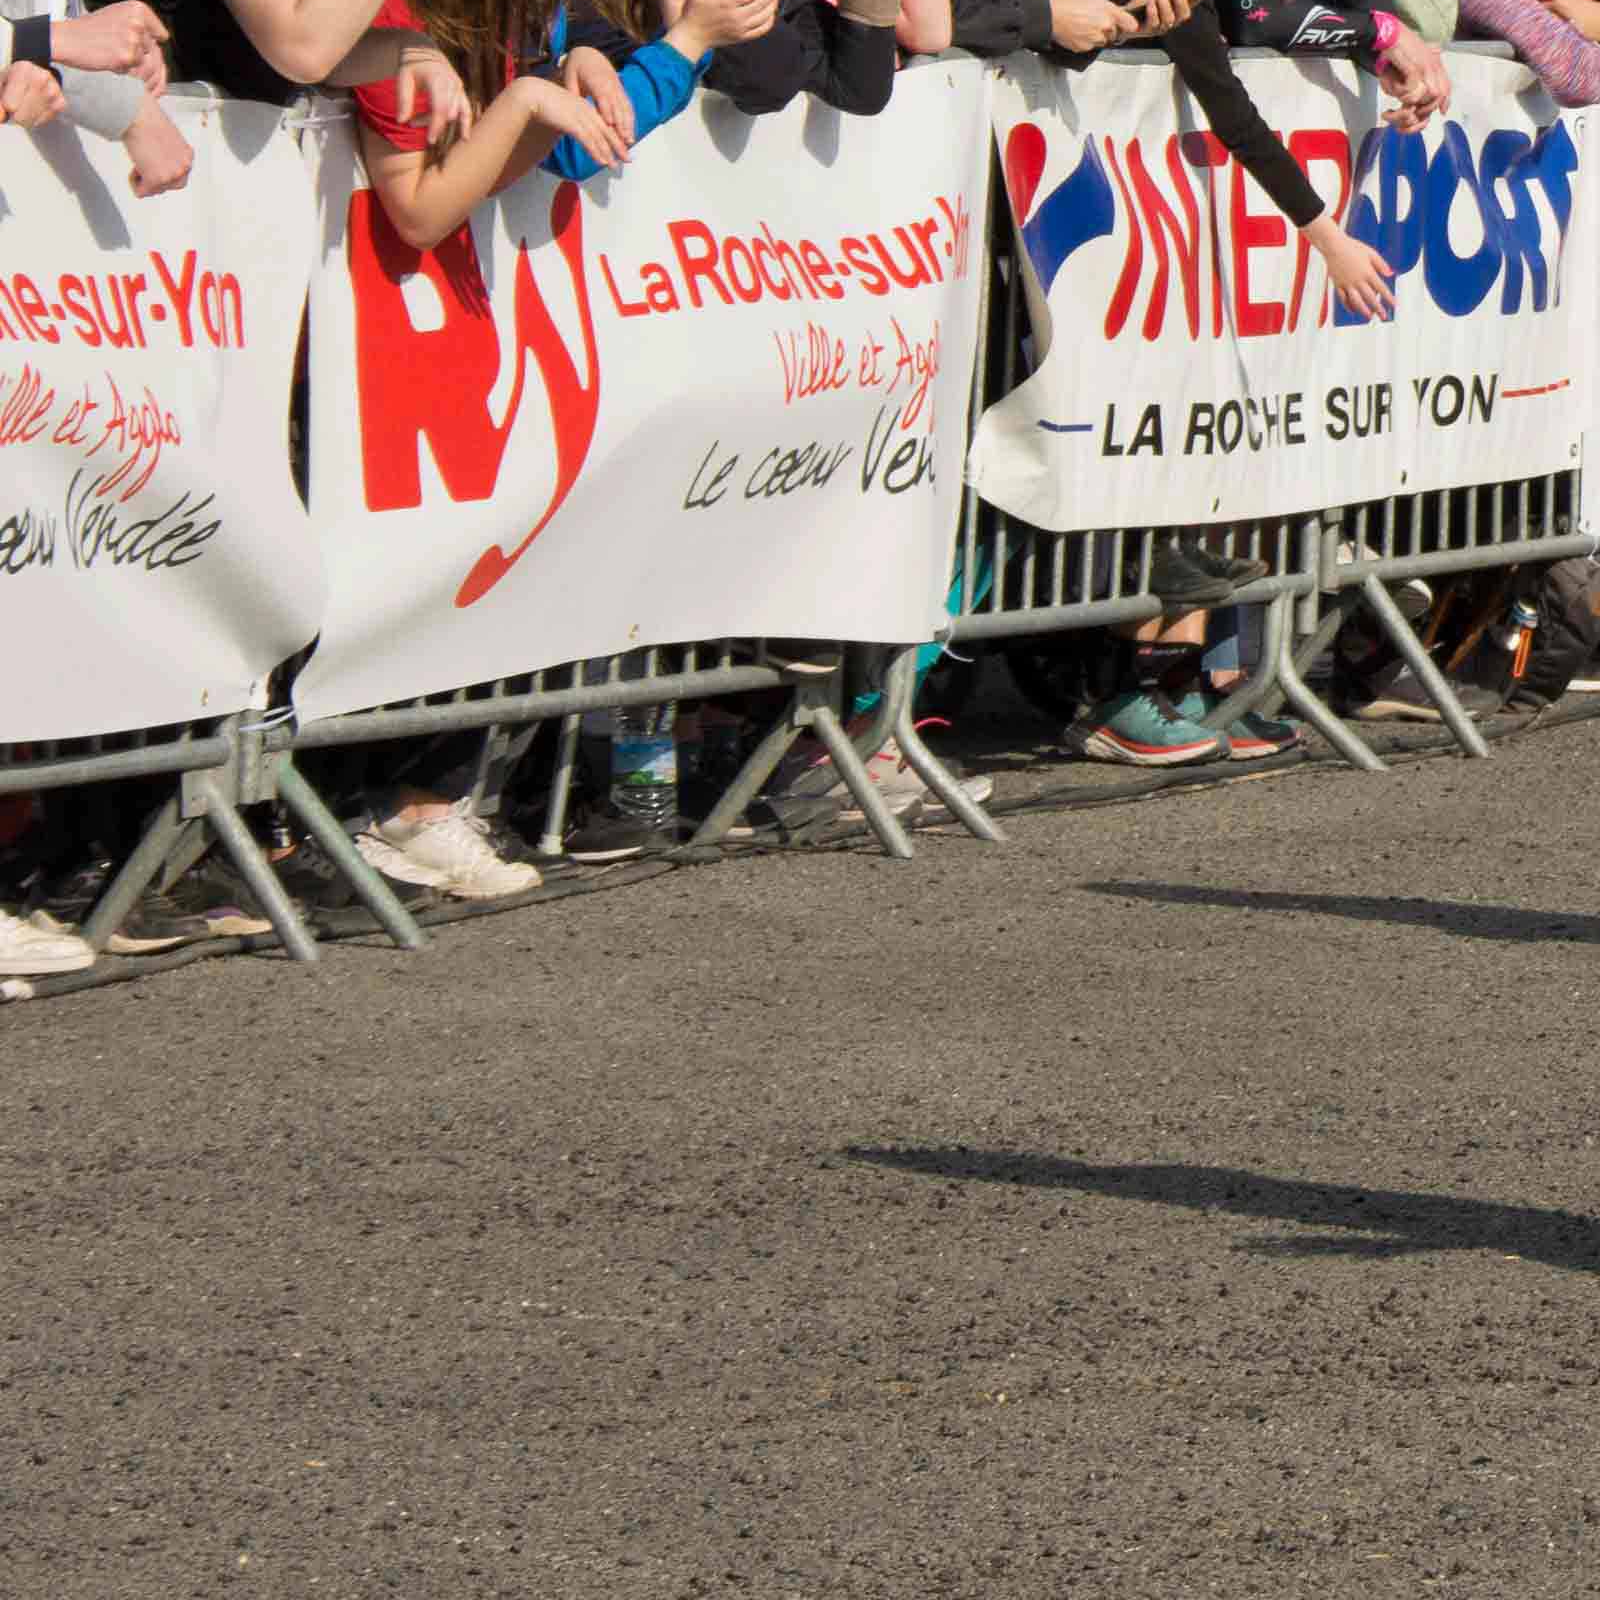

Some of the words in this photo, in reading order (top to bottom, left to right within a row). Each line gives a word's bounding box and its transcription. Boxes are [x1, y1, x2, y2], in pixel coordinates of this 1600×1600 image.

[0, 361, 55, 447] ille
[52, 380, 98, 446] et
[773, 320, 851, 404] Ville
[858, 329, 886, 388] et
[1101, 402, 1165, 457] LA
[1183, 391, 1306, 456] ROCHE
[1324, 381, 1394, 441] SUR
[1411, 373, 1500, 429] YON
[682, 440, 738, 510] Le
